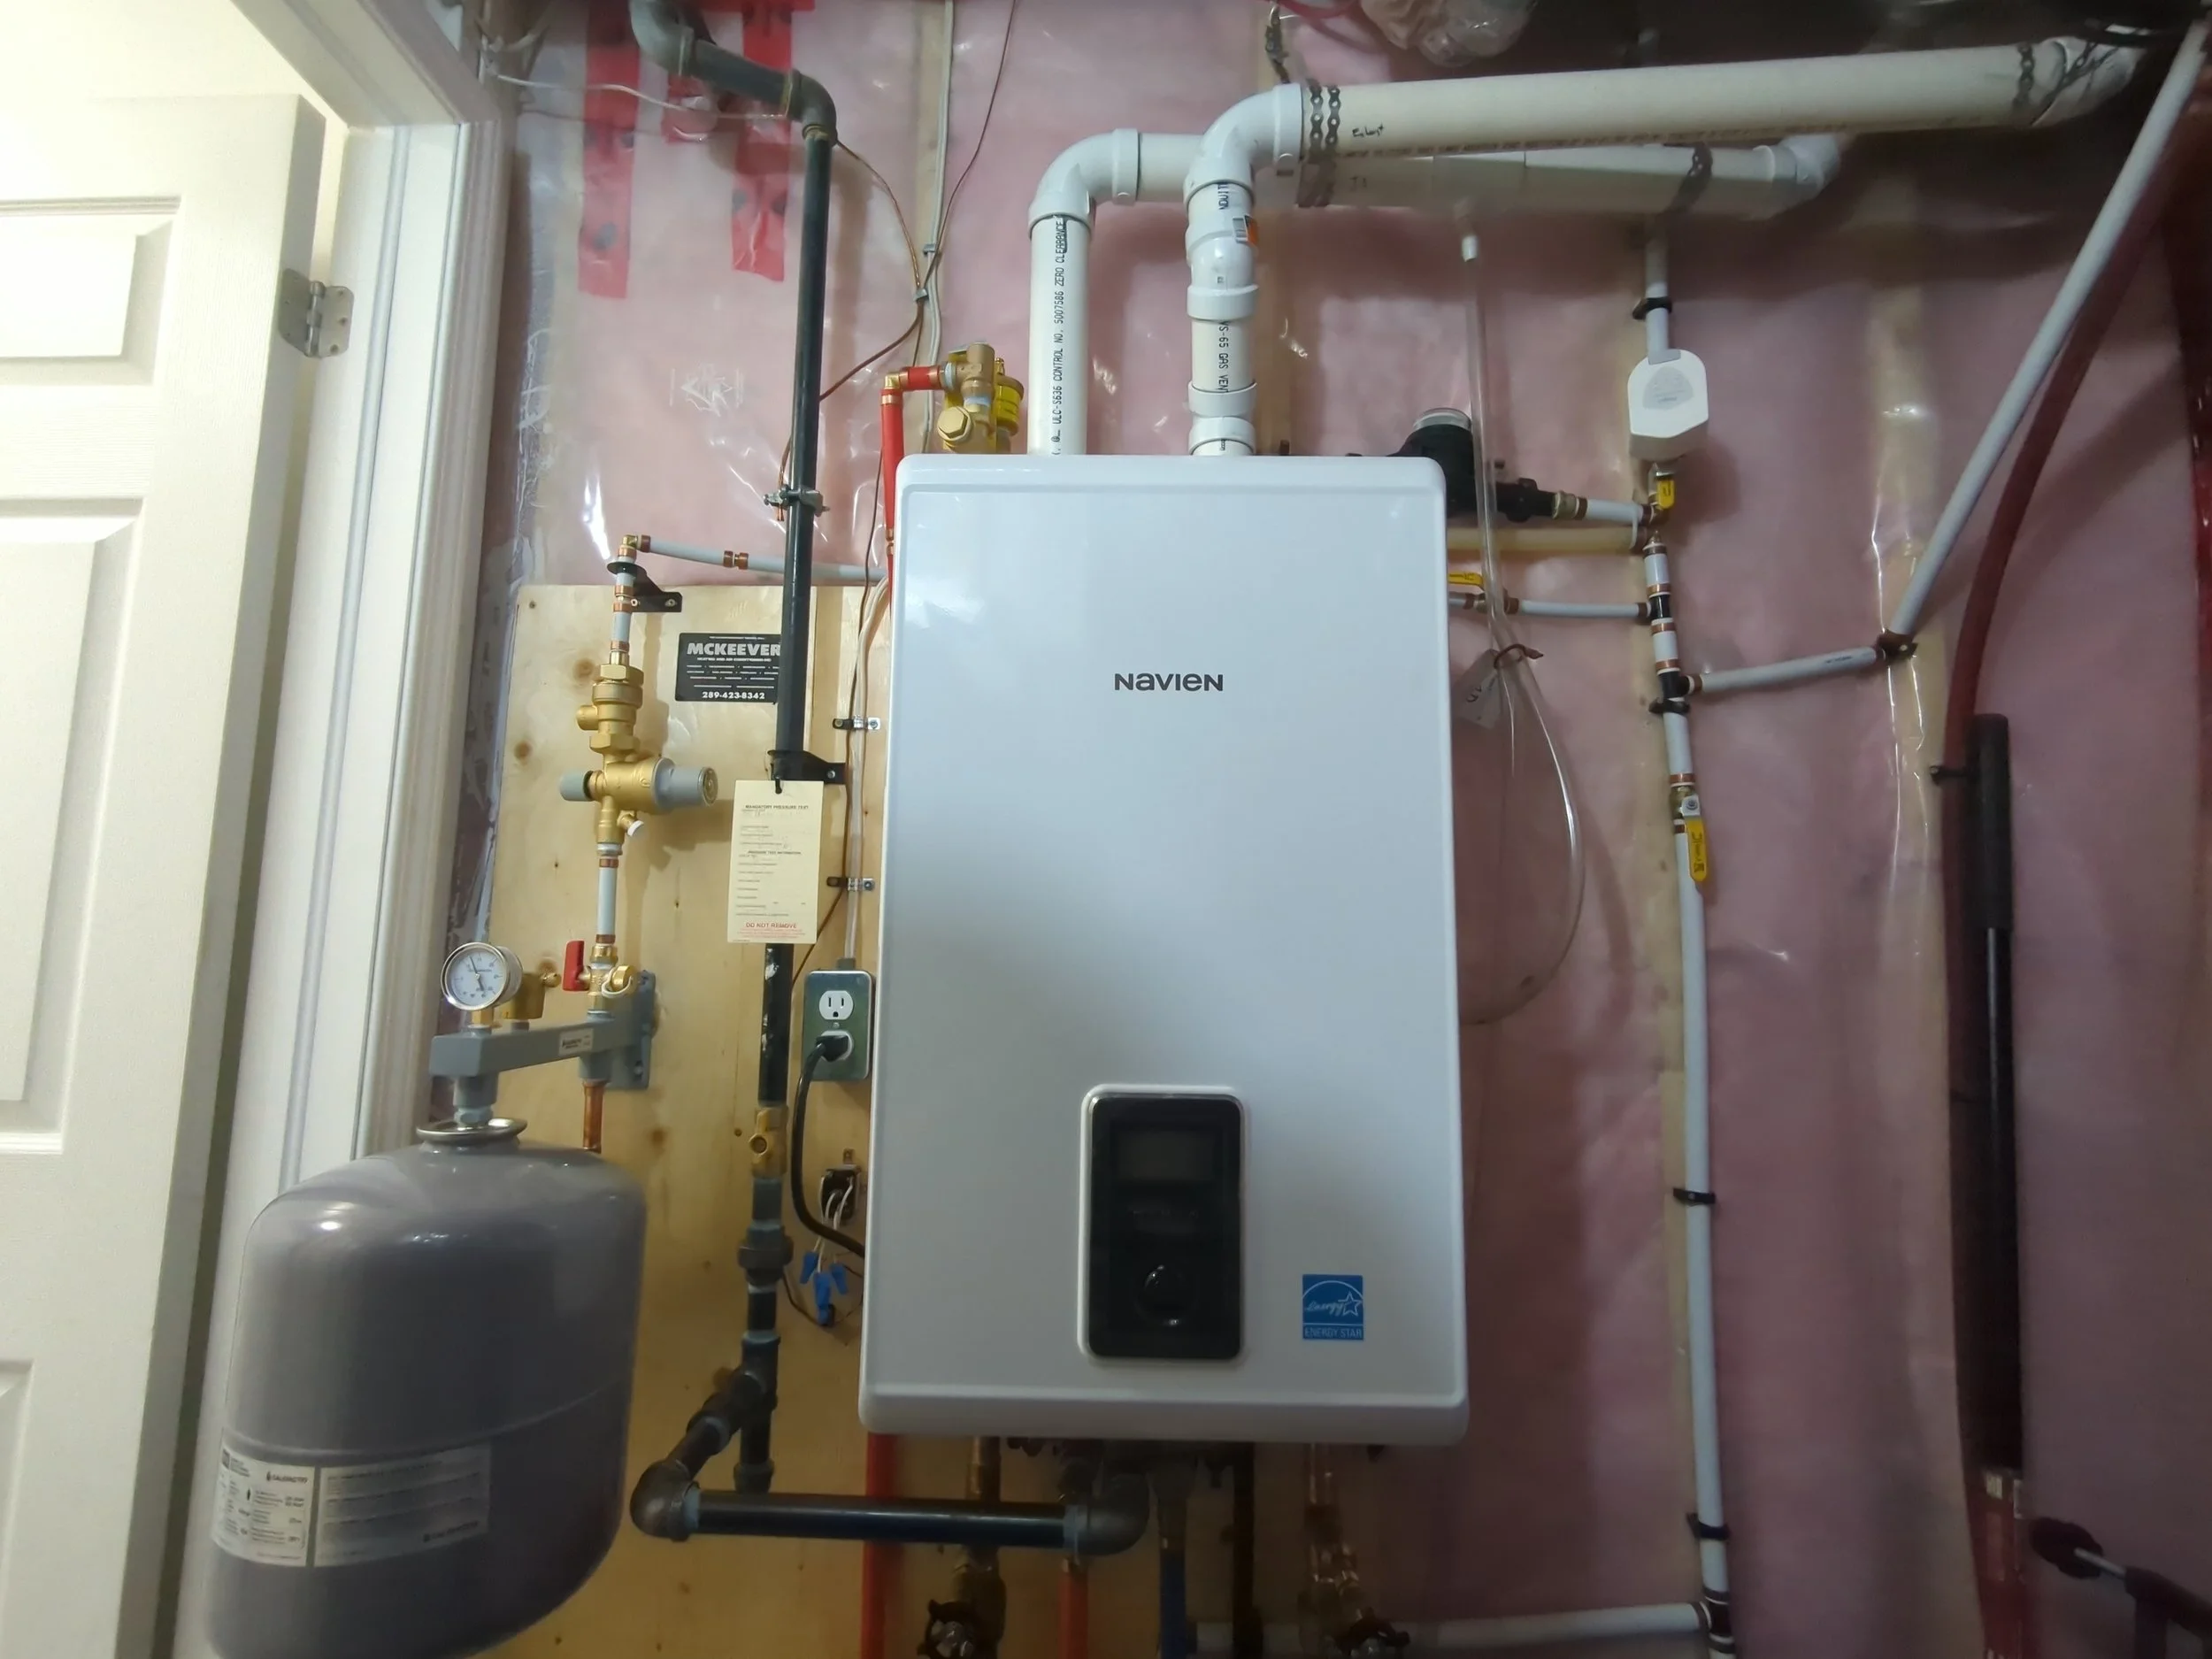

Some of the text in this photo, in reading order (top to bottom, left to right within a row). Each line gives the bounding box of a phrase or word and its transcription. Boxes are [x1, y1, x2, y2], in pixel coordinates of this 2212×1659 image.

[1055, 221, 1065, 264] CLEARANCE
[1054, 267, 1064, 287] ZERO
[1053, 329, 1064, 343] NO.
[1053, 348, 1063, 381] CONTROL
[1218, 353, 1229, 369] GAS
[1052, 386, 1062, 425] ULC-S636
[687, 642, 780, 656] MCKEEVER
[1304, 1326, 1363, 1338] ENERGY STAR
